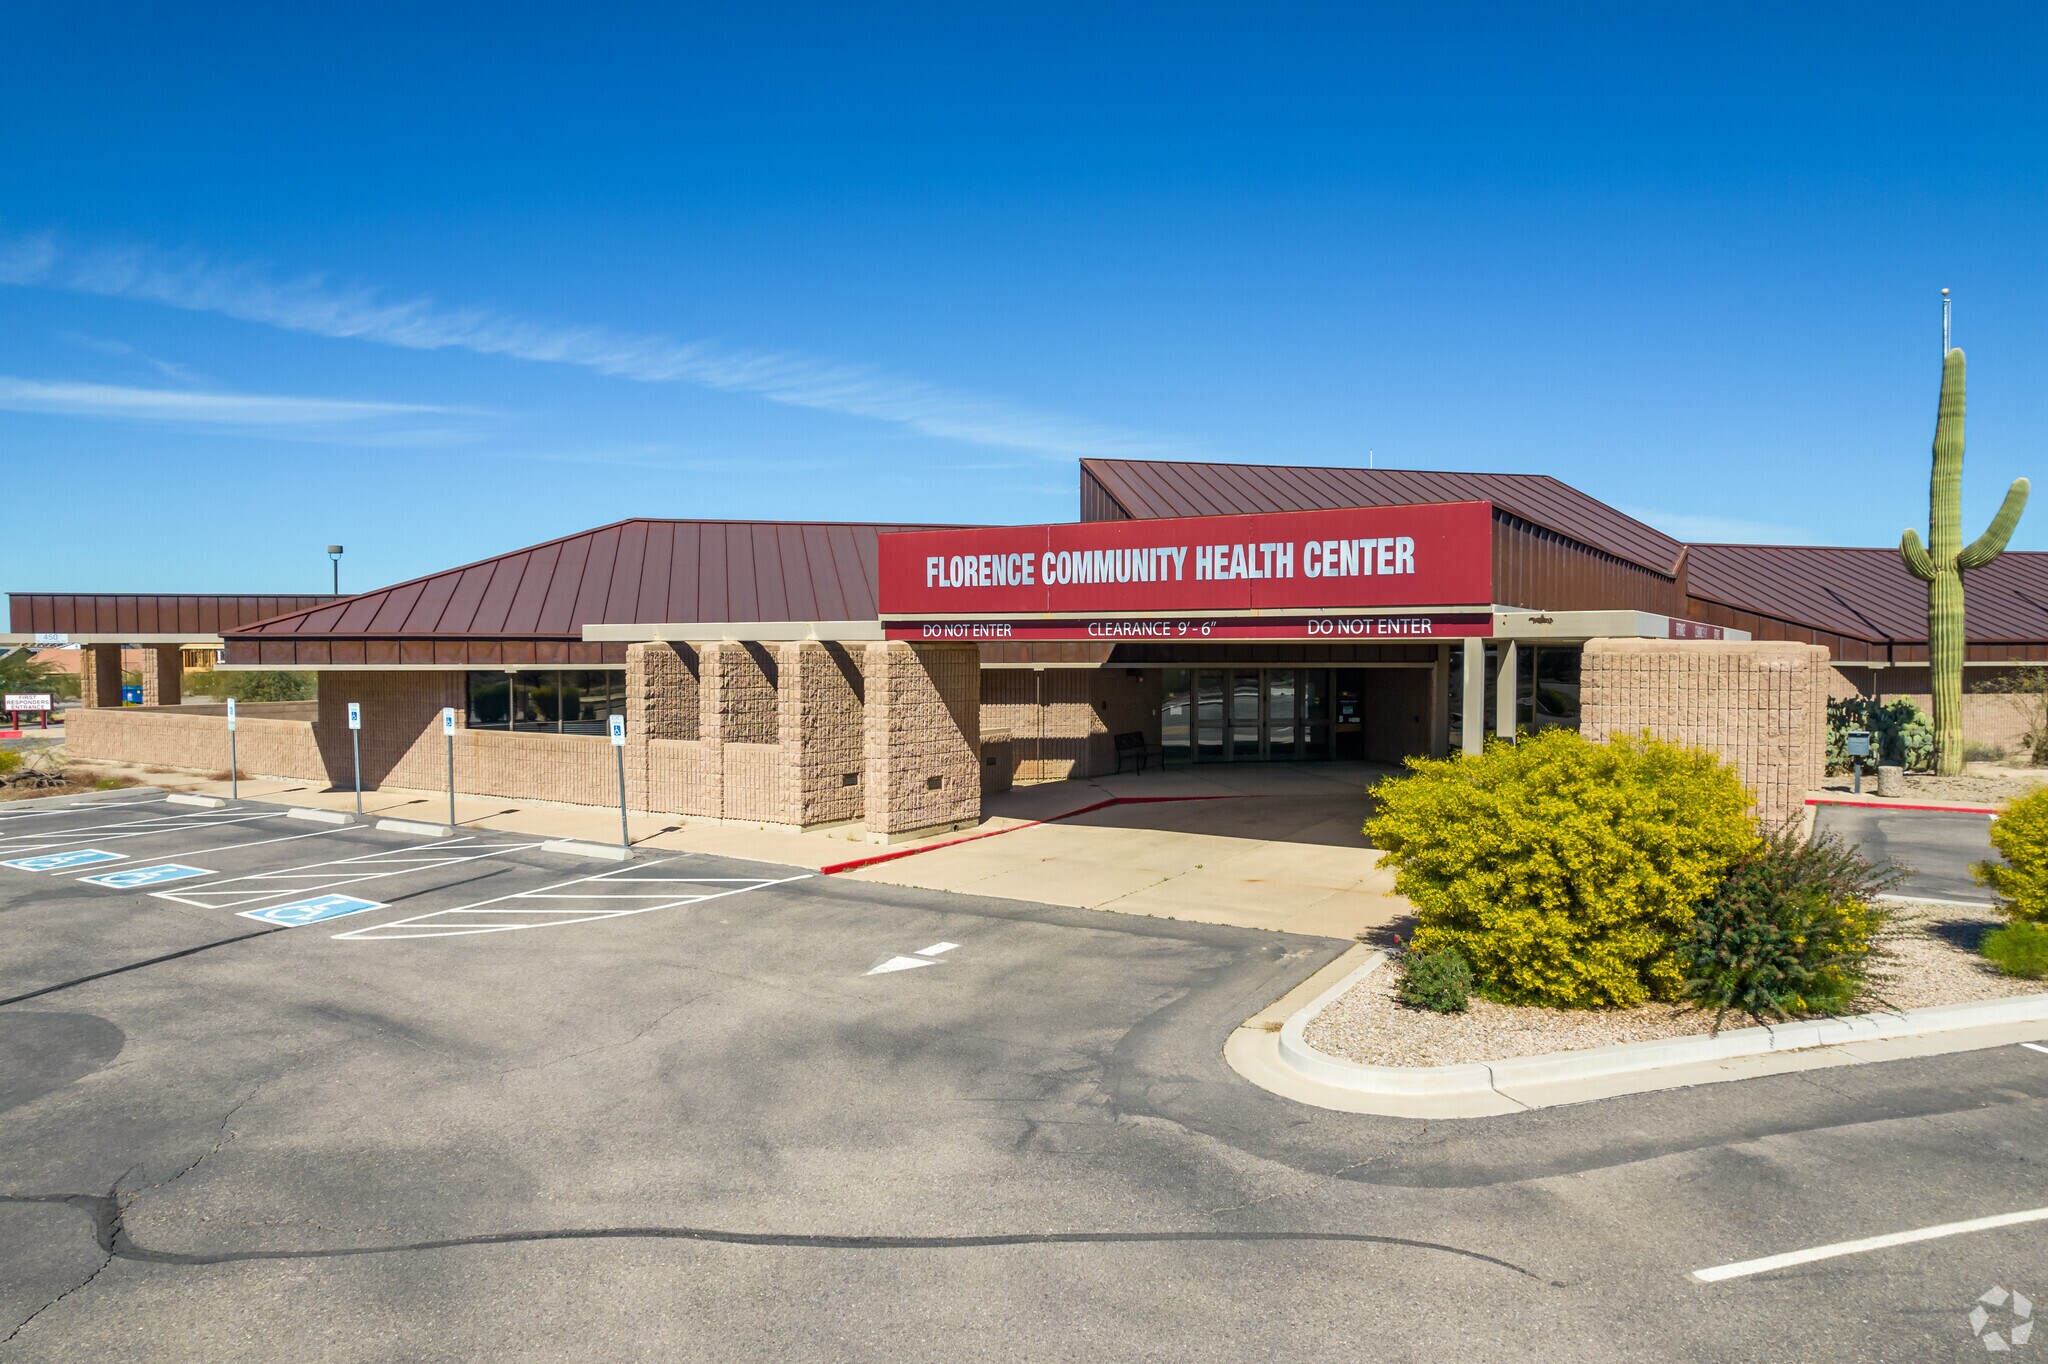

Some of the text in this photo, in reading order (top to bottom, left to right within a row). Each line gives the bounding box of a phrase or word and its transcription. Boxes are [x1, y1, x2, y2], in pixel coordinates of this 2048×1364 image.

[926, 537, 1416, 588] FLORENCE COMMUNITY HEALTH CENTER
[923, 623, 1012, 637] DO NOT ENTER
[1087, 621, 1171, 636] CLEARANCE
[1307, 619, 1432, 635] DO NOT ENTER
